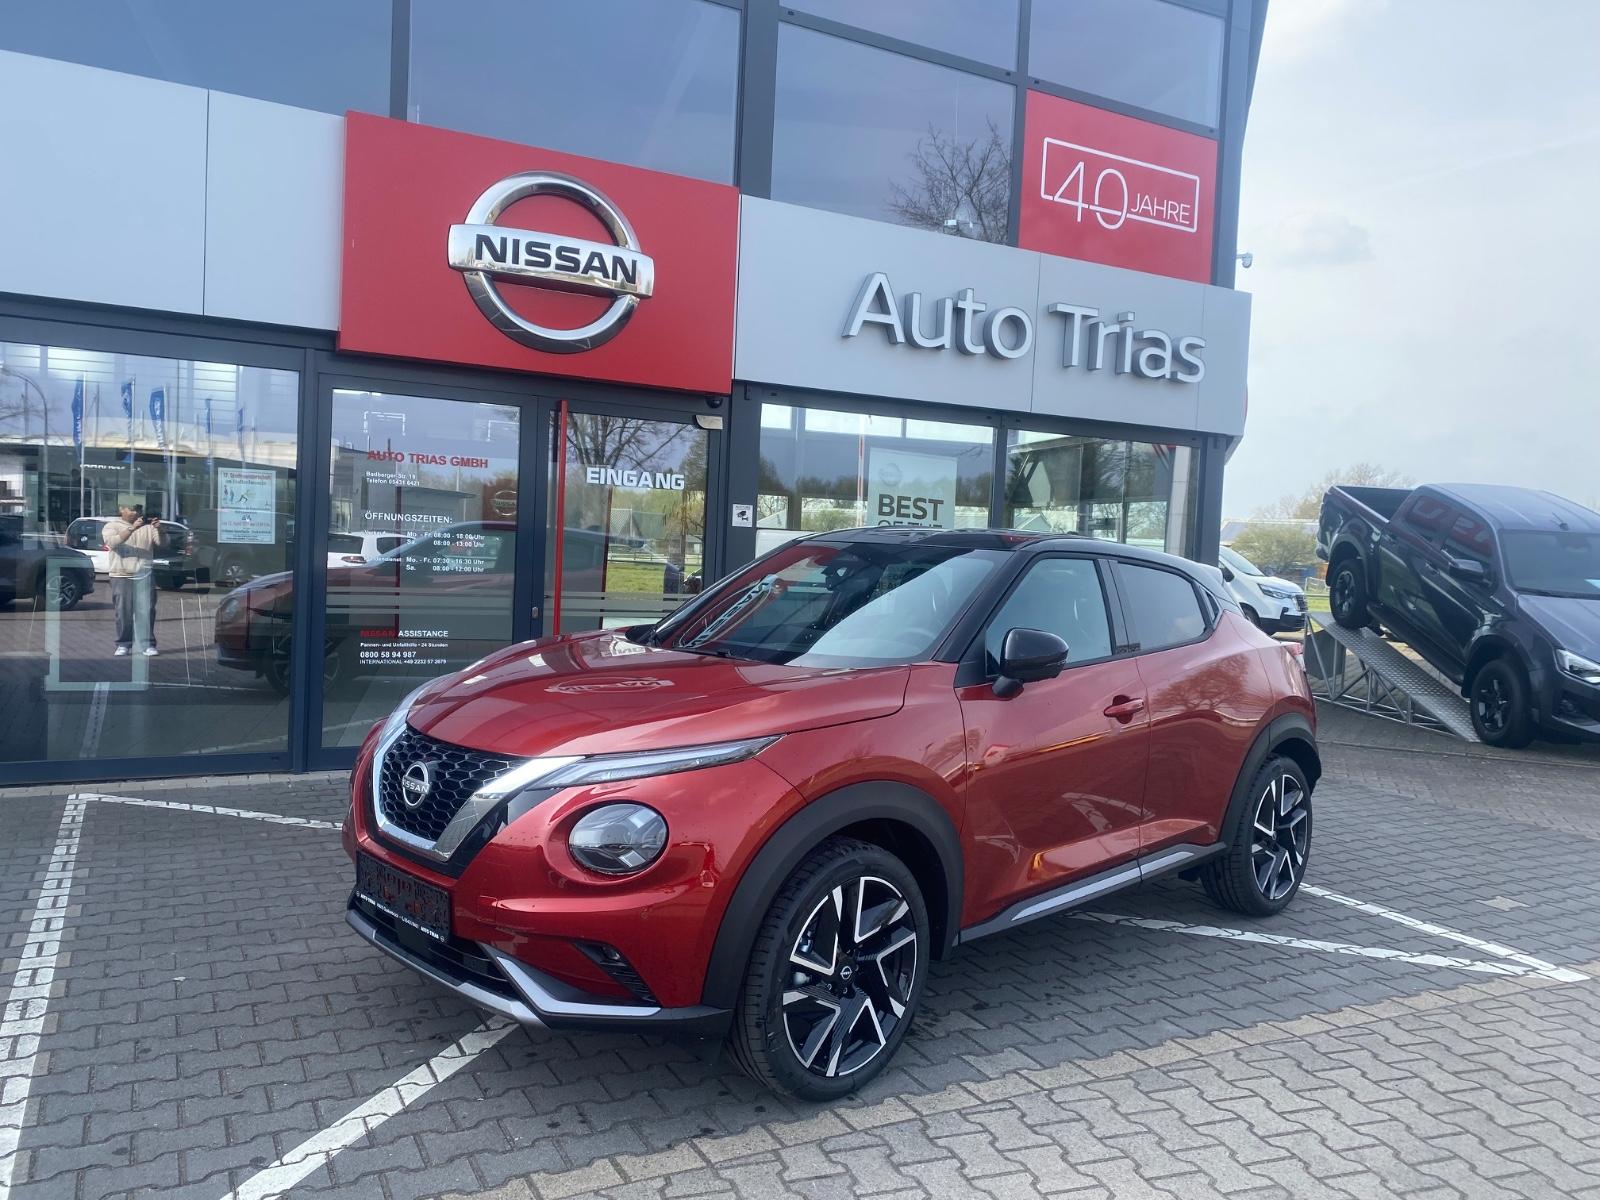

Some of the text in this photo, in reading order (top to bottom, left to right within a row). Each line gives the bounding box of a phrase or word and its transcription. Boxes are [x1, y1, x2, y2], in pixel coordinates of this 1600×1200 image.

[1053, 161, 1191, 230] 40 JAHRE
[475, 233, 637, 284] NISSAN
[842, 272, 1206, 384] Auto Trias
[368, 450, 488, 468] AUTO TRIAS GMBH
[586, 467, 685, 490] EINGANG
[364, 510, 453, 524] ÖFFNUNGSZEITEN:
[878, 493, 944, 521] BEST
